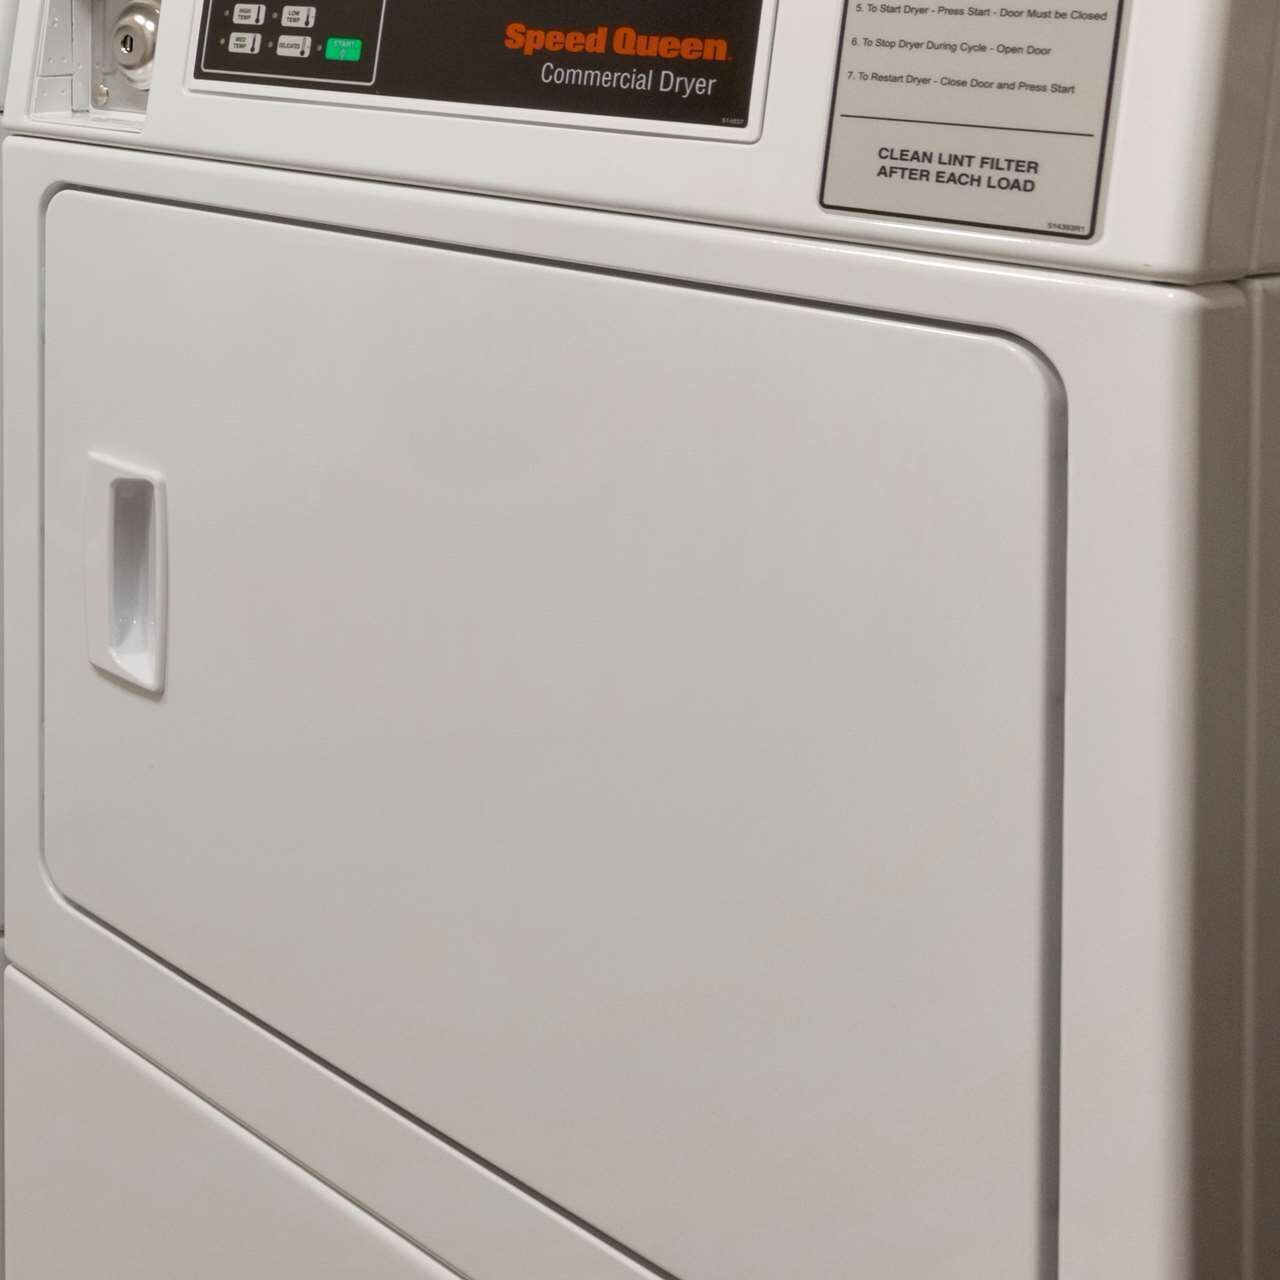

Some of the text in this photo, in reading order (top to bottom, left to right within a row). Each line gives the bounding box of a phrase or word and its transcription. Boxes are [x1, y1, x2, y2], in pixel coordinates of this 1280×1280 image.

[856, 4, 1108, 20] 5. To Start Dryer Press Start Door Must be Closed
[334, 40, 355, 48] START
[505, 22, 728, 60] Speed Queen
[852, 37, 1051, 55] 6. To Stop Dryer During Cycle Open Door
[541, 62, 717, 98] Commercial Dryer
[848, 71, 1075, 94] 7. To Restart Dryer Close Door and Press Start
[878, 147, 1039, 174] CLEAN LINT FILTER
[877, 166, 1035, 192] AFTER EACH LOAD
